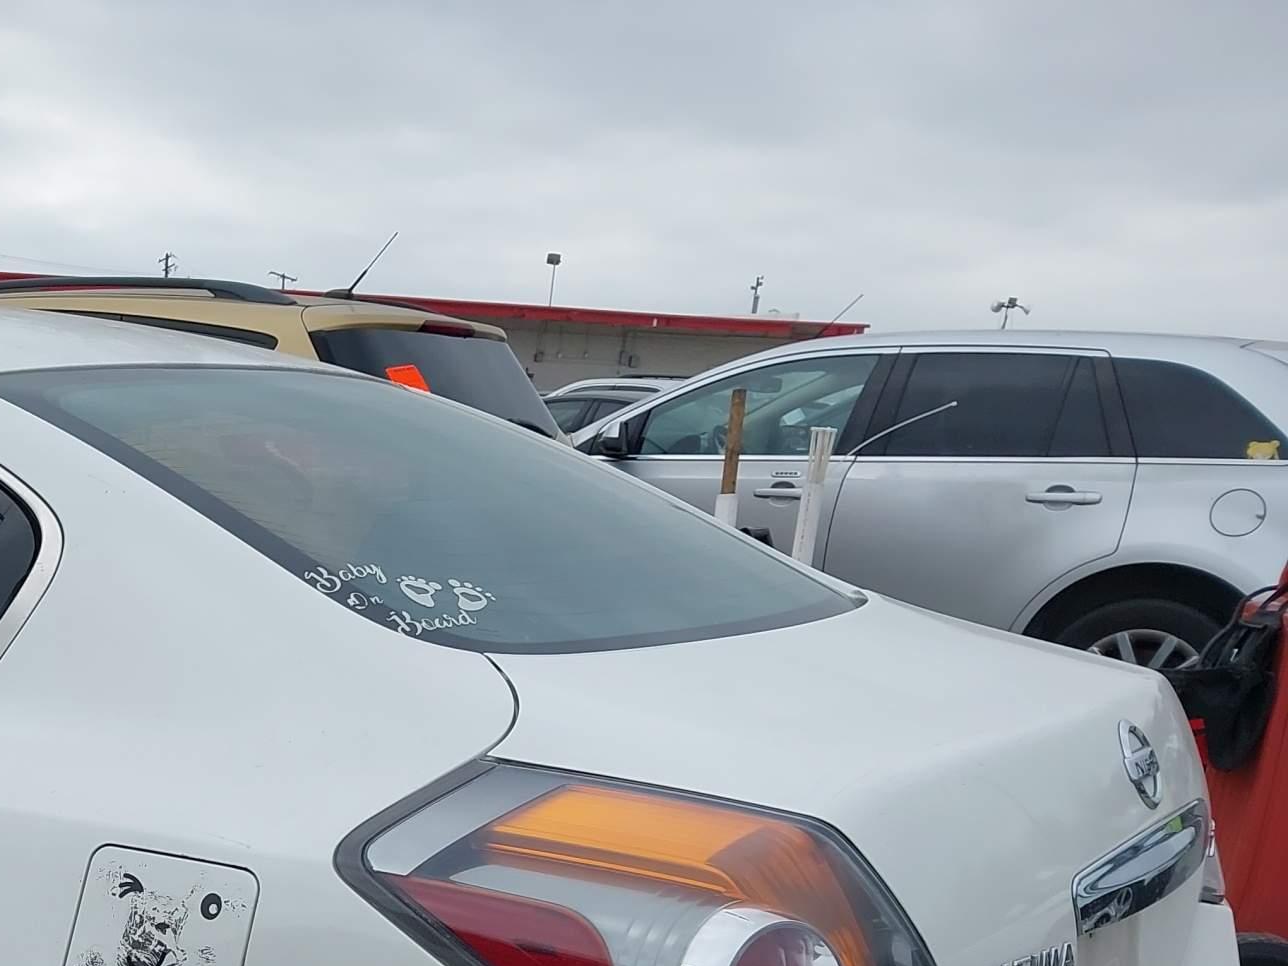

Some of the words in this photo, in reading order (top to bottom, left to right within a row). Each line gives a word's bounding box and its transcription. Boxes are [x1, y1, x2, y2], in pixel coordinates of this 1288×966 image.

[304, 563, 388, 593] Baby
[346, 592, 384, 610] On
[386, 609, 477, 636] Board
